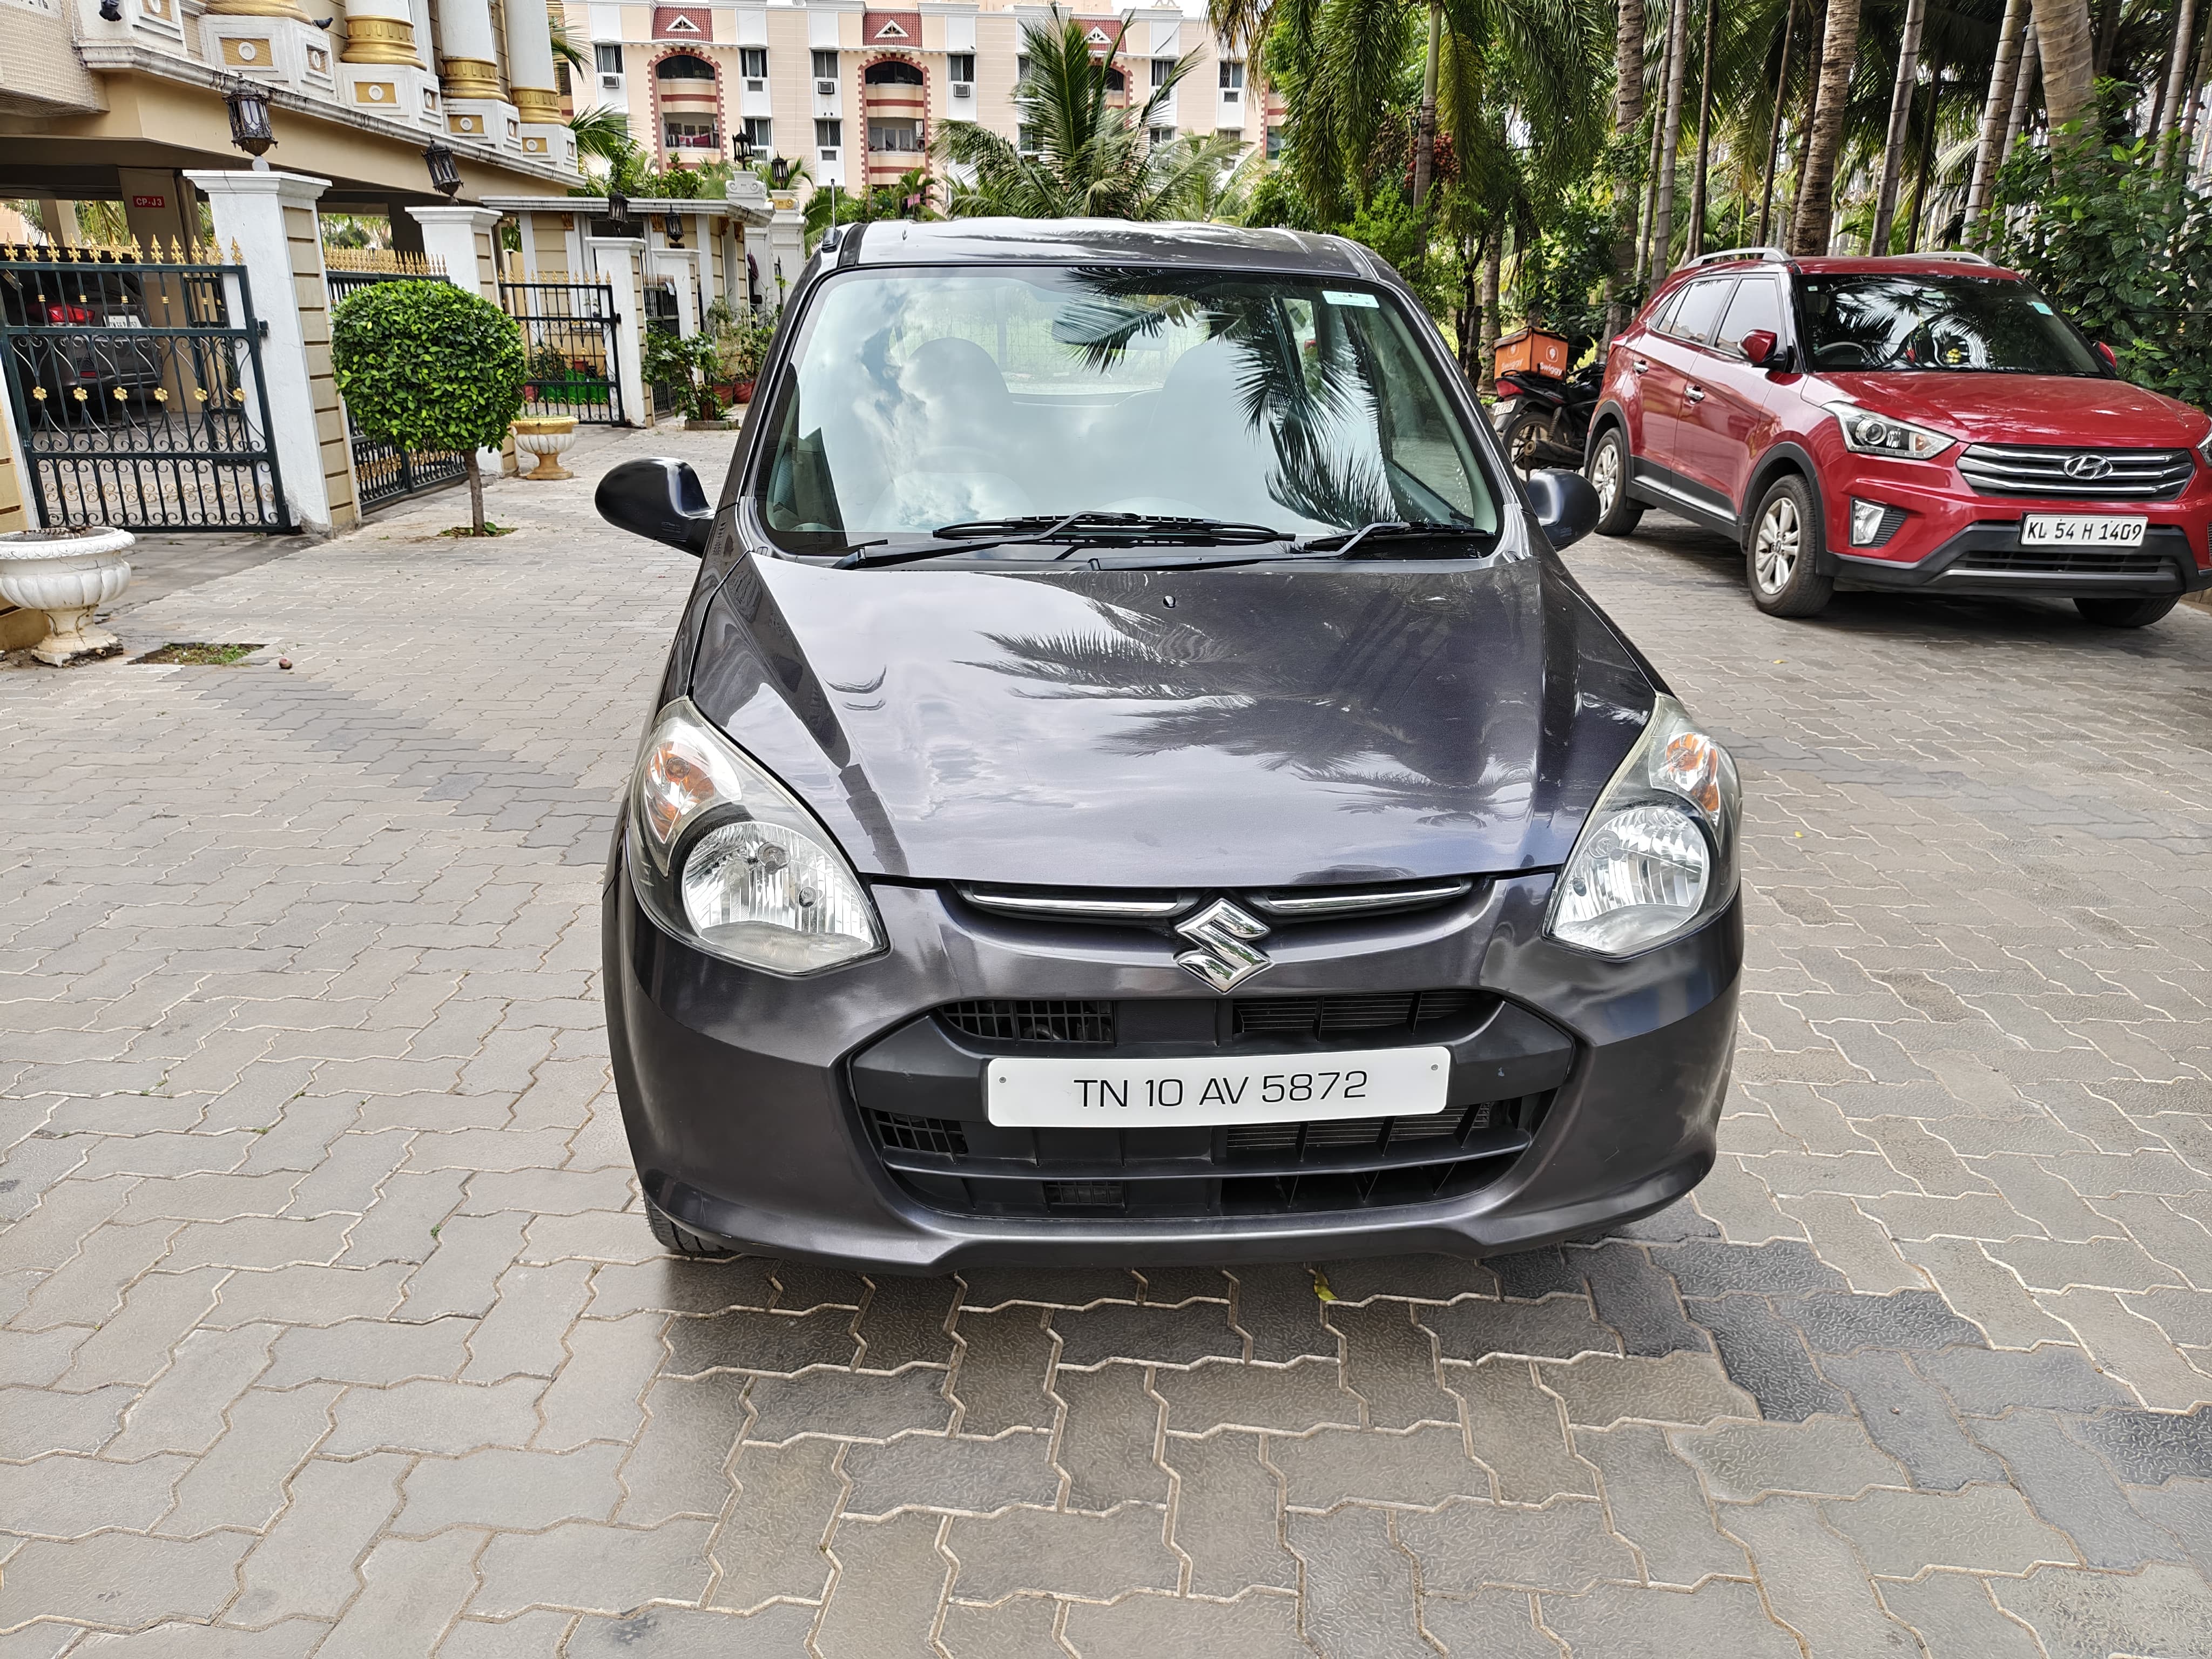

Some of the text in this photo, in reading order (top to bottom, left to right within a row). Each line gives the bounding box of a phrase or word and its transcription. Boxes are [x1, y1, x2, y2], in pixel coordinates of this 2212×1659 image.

[1539, 361, 1563, 376] Swiggy
[2027, 522, 2143, 541] KL 54 H 1409
[1073, 1070, 1368, 1108] TN 10 AV 5872
